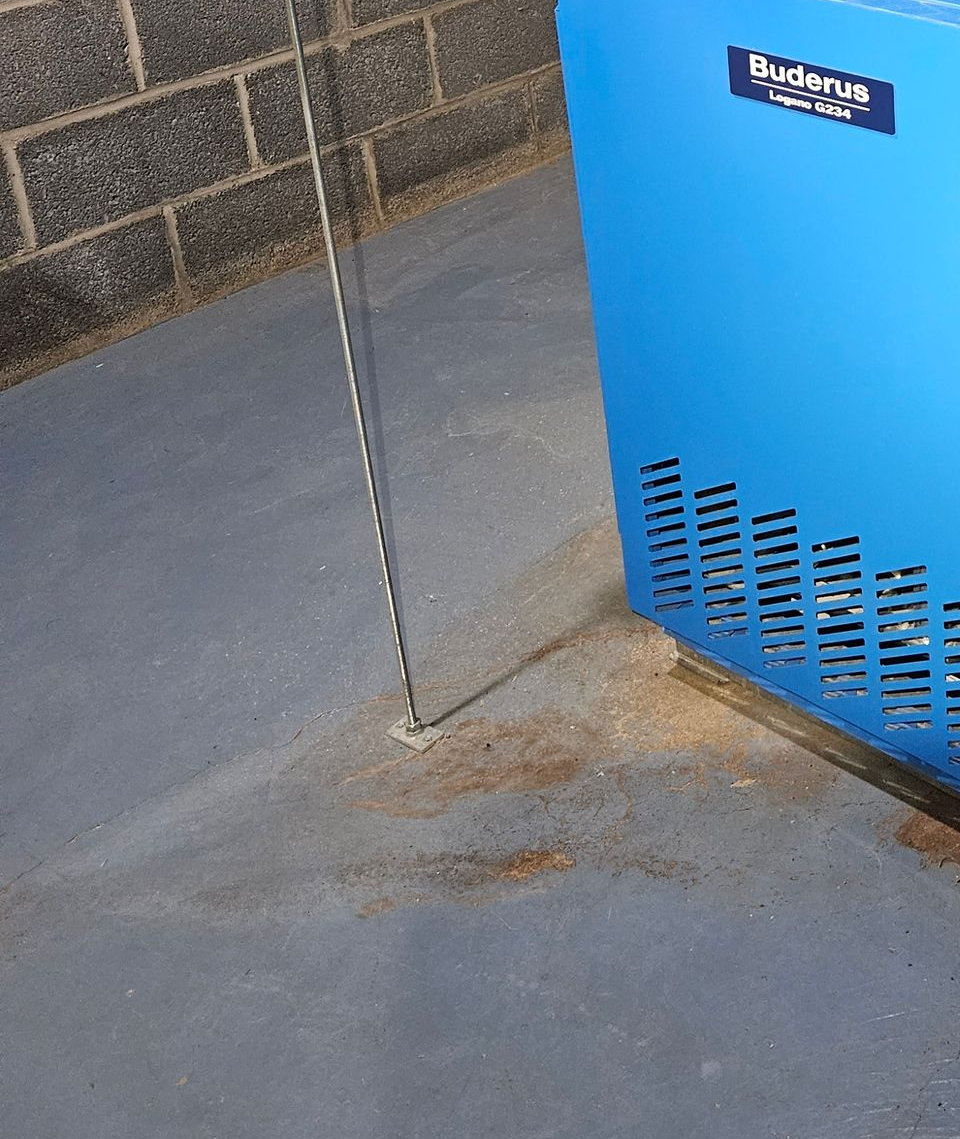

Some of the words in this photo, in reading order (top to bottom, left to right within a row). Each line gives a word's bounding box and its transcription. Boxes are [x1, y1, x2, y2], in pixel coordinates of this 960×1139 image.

[749, 53, 870, 103] Buderus
[769, 89, 812, 110] Logano
[814, 102, 852, 120] G234
